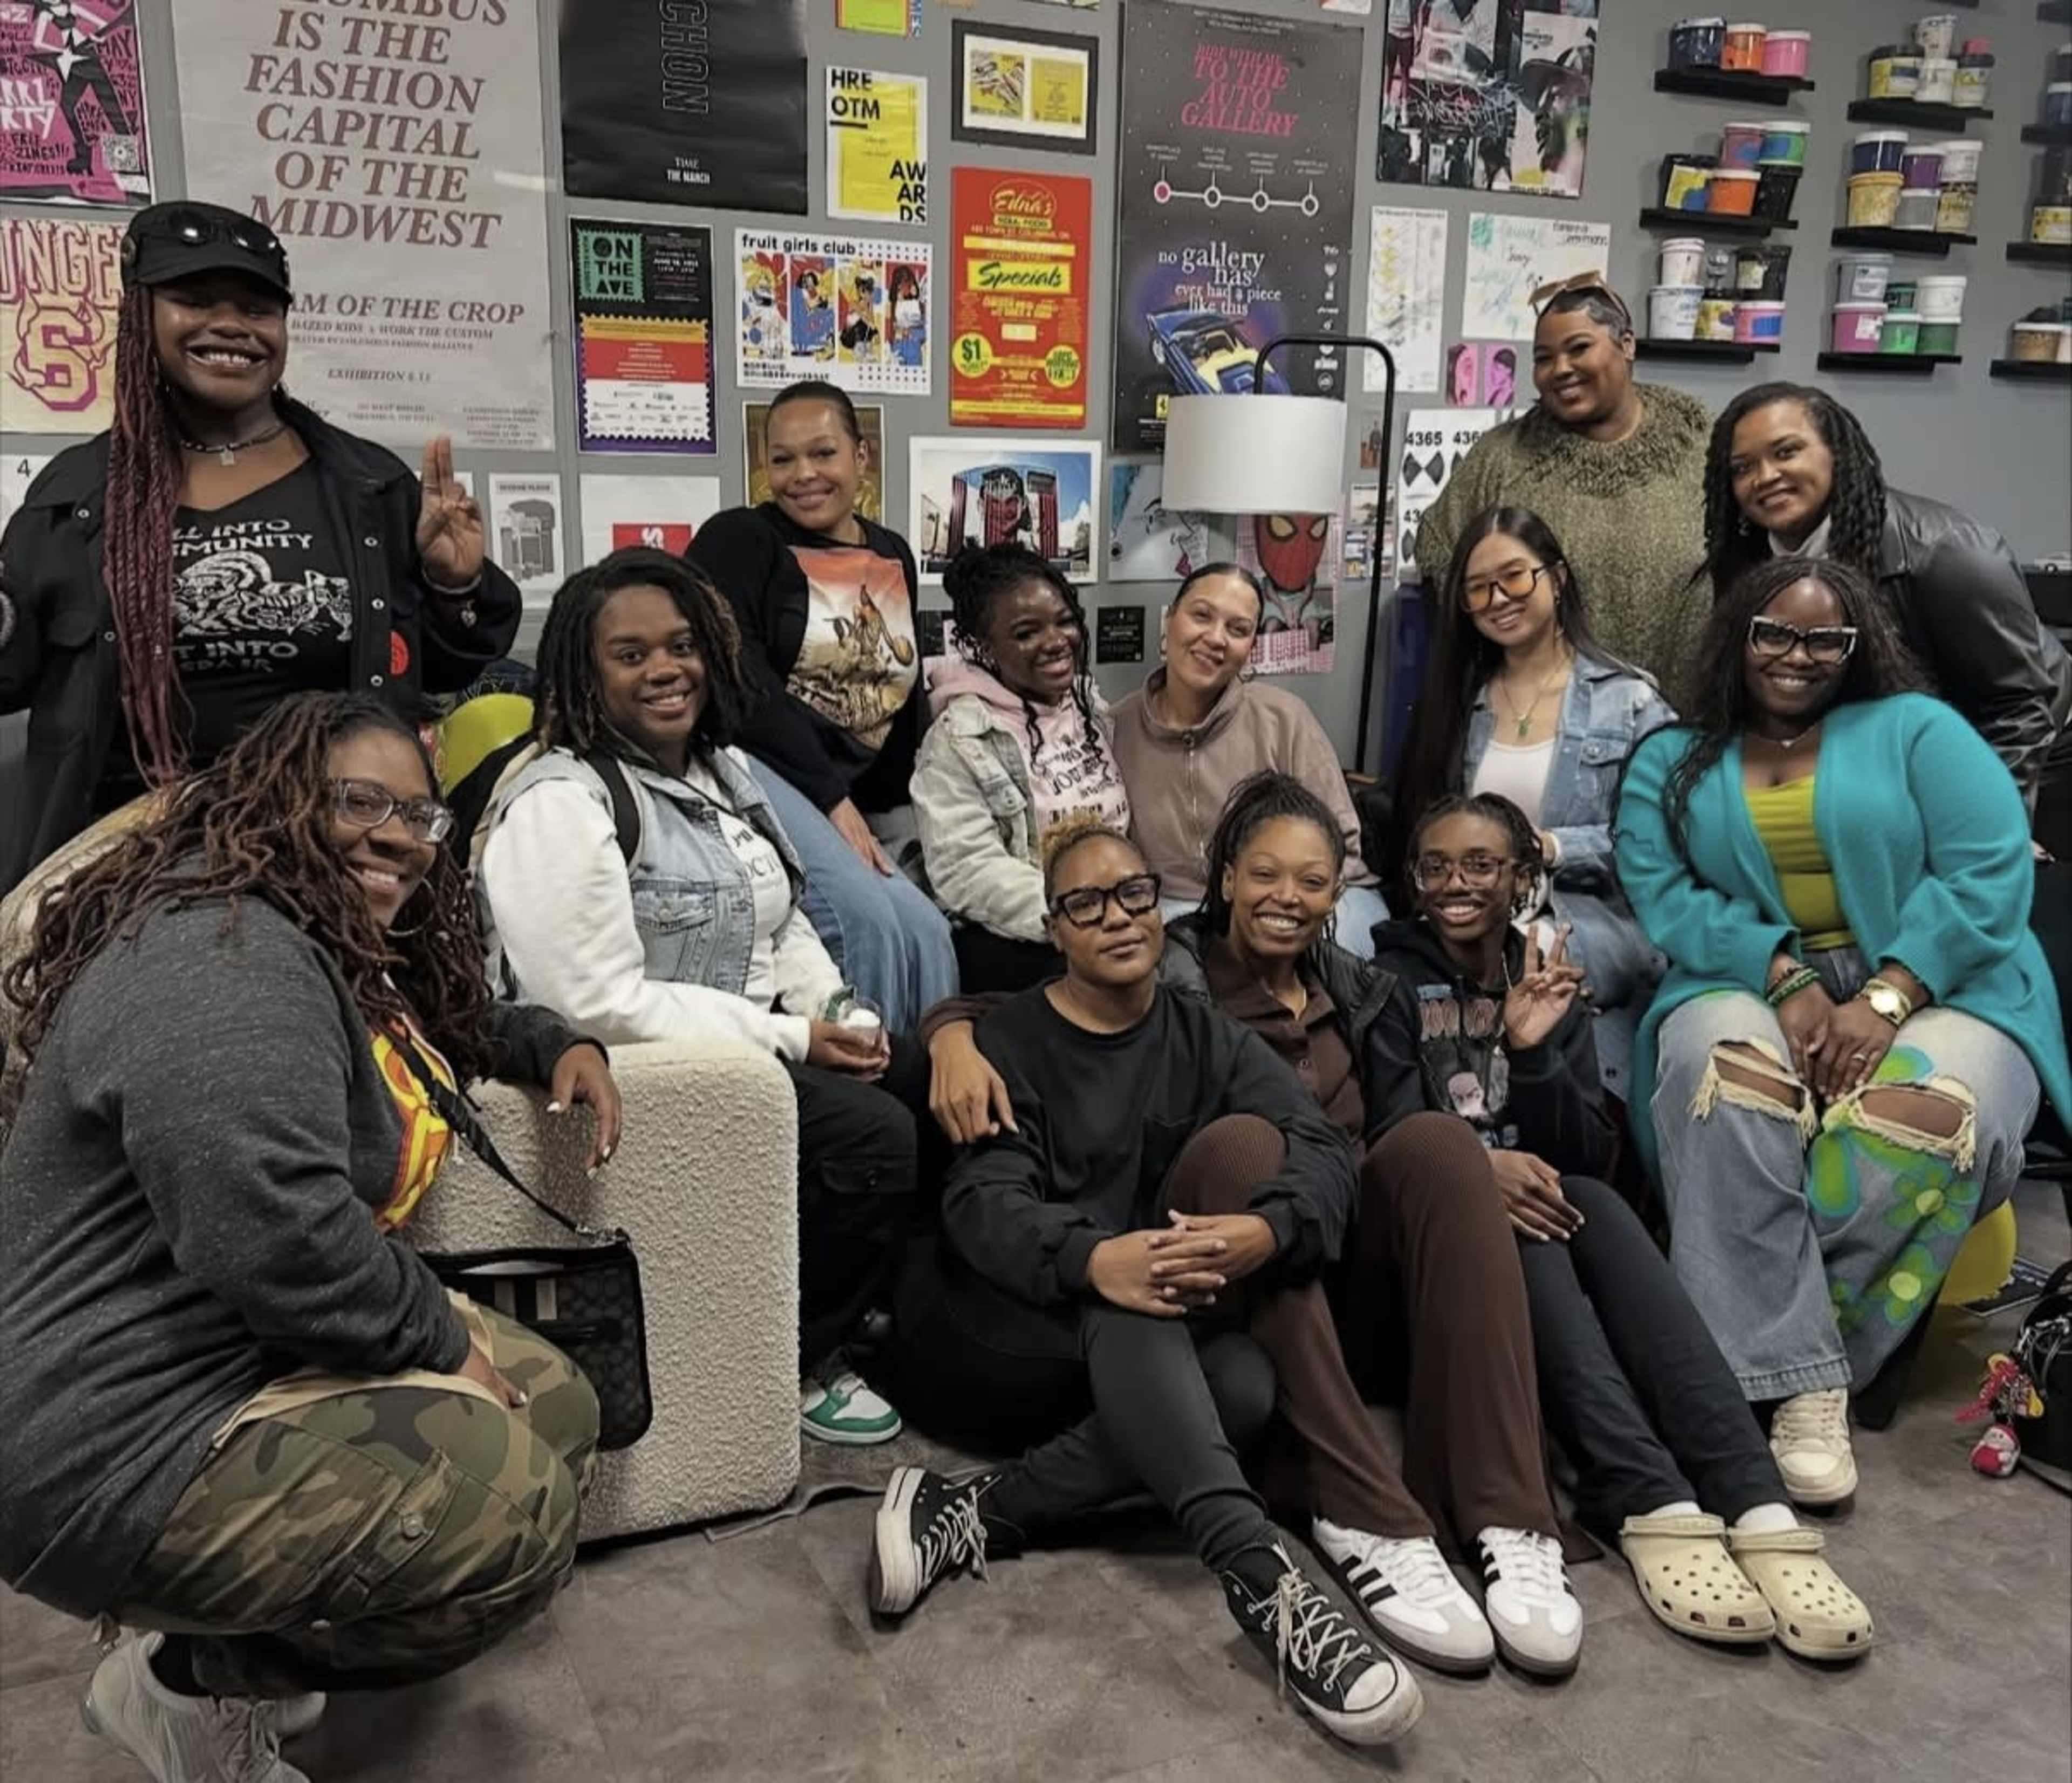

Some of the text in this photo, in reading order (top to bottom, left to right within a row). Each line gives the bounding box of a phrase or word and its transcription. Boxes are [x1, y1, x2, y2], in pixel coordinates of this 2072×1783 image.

[273, 9, 451, 65] IS THE
[244, 53, 485, 114] FASHION
[831, 69, 873, 91] HRE
[831, 95, 881, 120] OTM
[256, 102, 481, 159] CAPITAL
[1182, 102, 1299, 137] GALLERY
[275, 151, 468, 203] OF THE
[890, 160, 926, 181] AW
[897, 183, 926, 204] AR
[250, 194, 502, 249] MIDWEST
[592, 236, 632, 259] ON
[742, 234, 856, 255] fruit girls club
[595, 260, 635, 277] THE
[1158, 241, 1265, 278] no gallery
[978, 261, 1062, 289] Specials
[1214, 258, 1252, 287] has
[596, 279, 635, 296] AVE
[1207, 281, 1232, 298] had
[1246, 284, 1282, 304] piece
[337, 294, 377, 317] OF
[381, 296, 440, 320] THE
[448, 300, 524, 324] CROP
[1189, 293, 1249, 317] like this
[328, 368, 403, 382] EXHIBITION
[1405, 431, 1442, 446] 4365
[17, 459, 31, 477] 4
[212, 520, 290, 537] INTO
[206, 640, 298, 658] INTO
